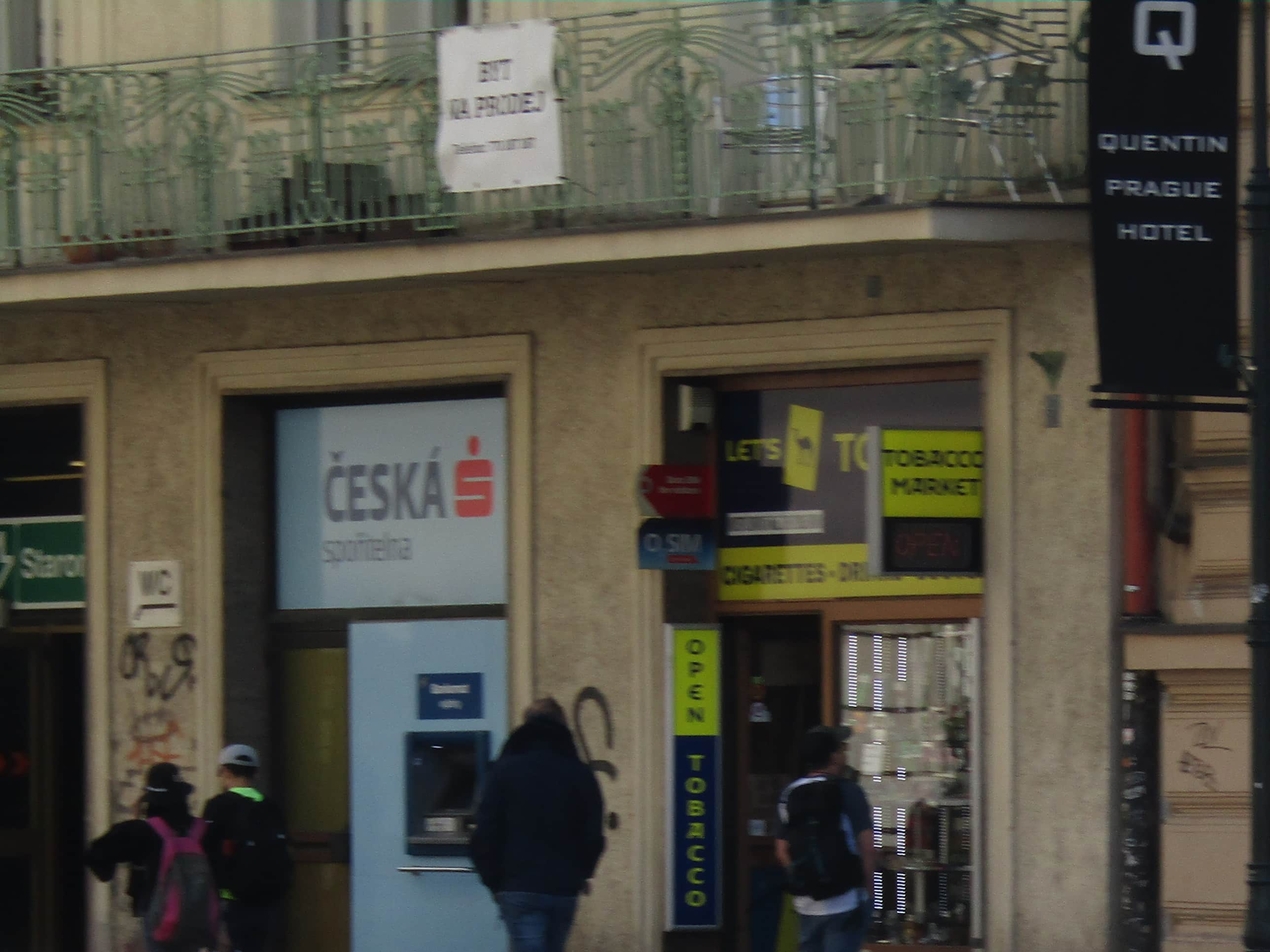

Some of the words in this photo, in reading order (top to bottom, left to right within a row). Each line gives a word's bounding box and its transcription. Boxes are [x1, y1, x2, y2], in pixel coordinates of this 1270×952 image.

[1098, 134, 1228, 153] QUENTIN
[1105, 179, 1222, 198] PRAGUE
[1117, 224, 1212, 241] HOTEL
[881, 449, 983, 468] TOBACCO
[325, 446, 448, 522] ČESKÁ
[890, 478, 982, 495] MARKET
[139, 569, 173, 596] WC
[685, 639, 706, 723] OPEN
[684, 754, 707, 907] TOBACCO
